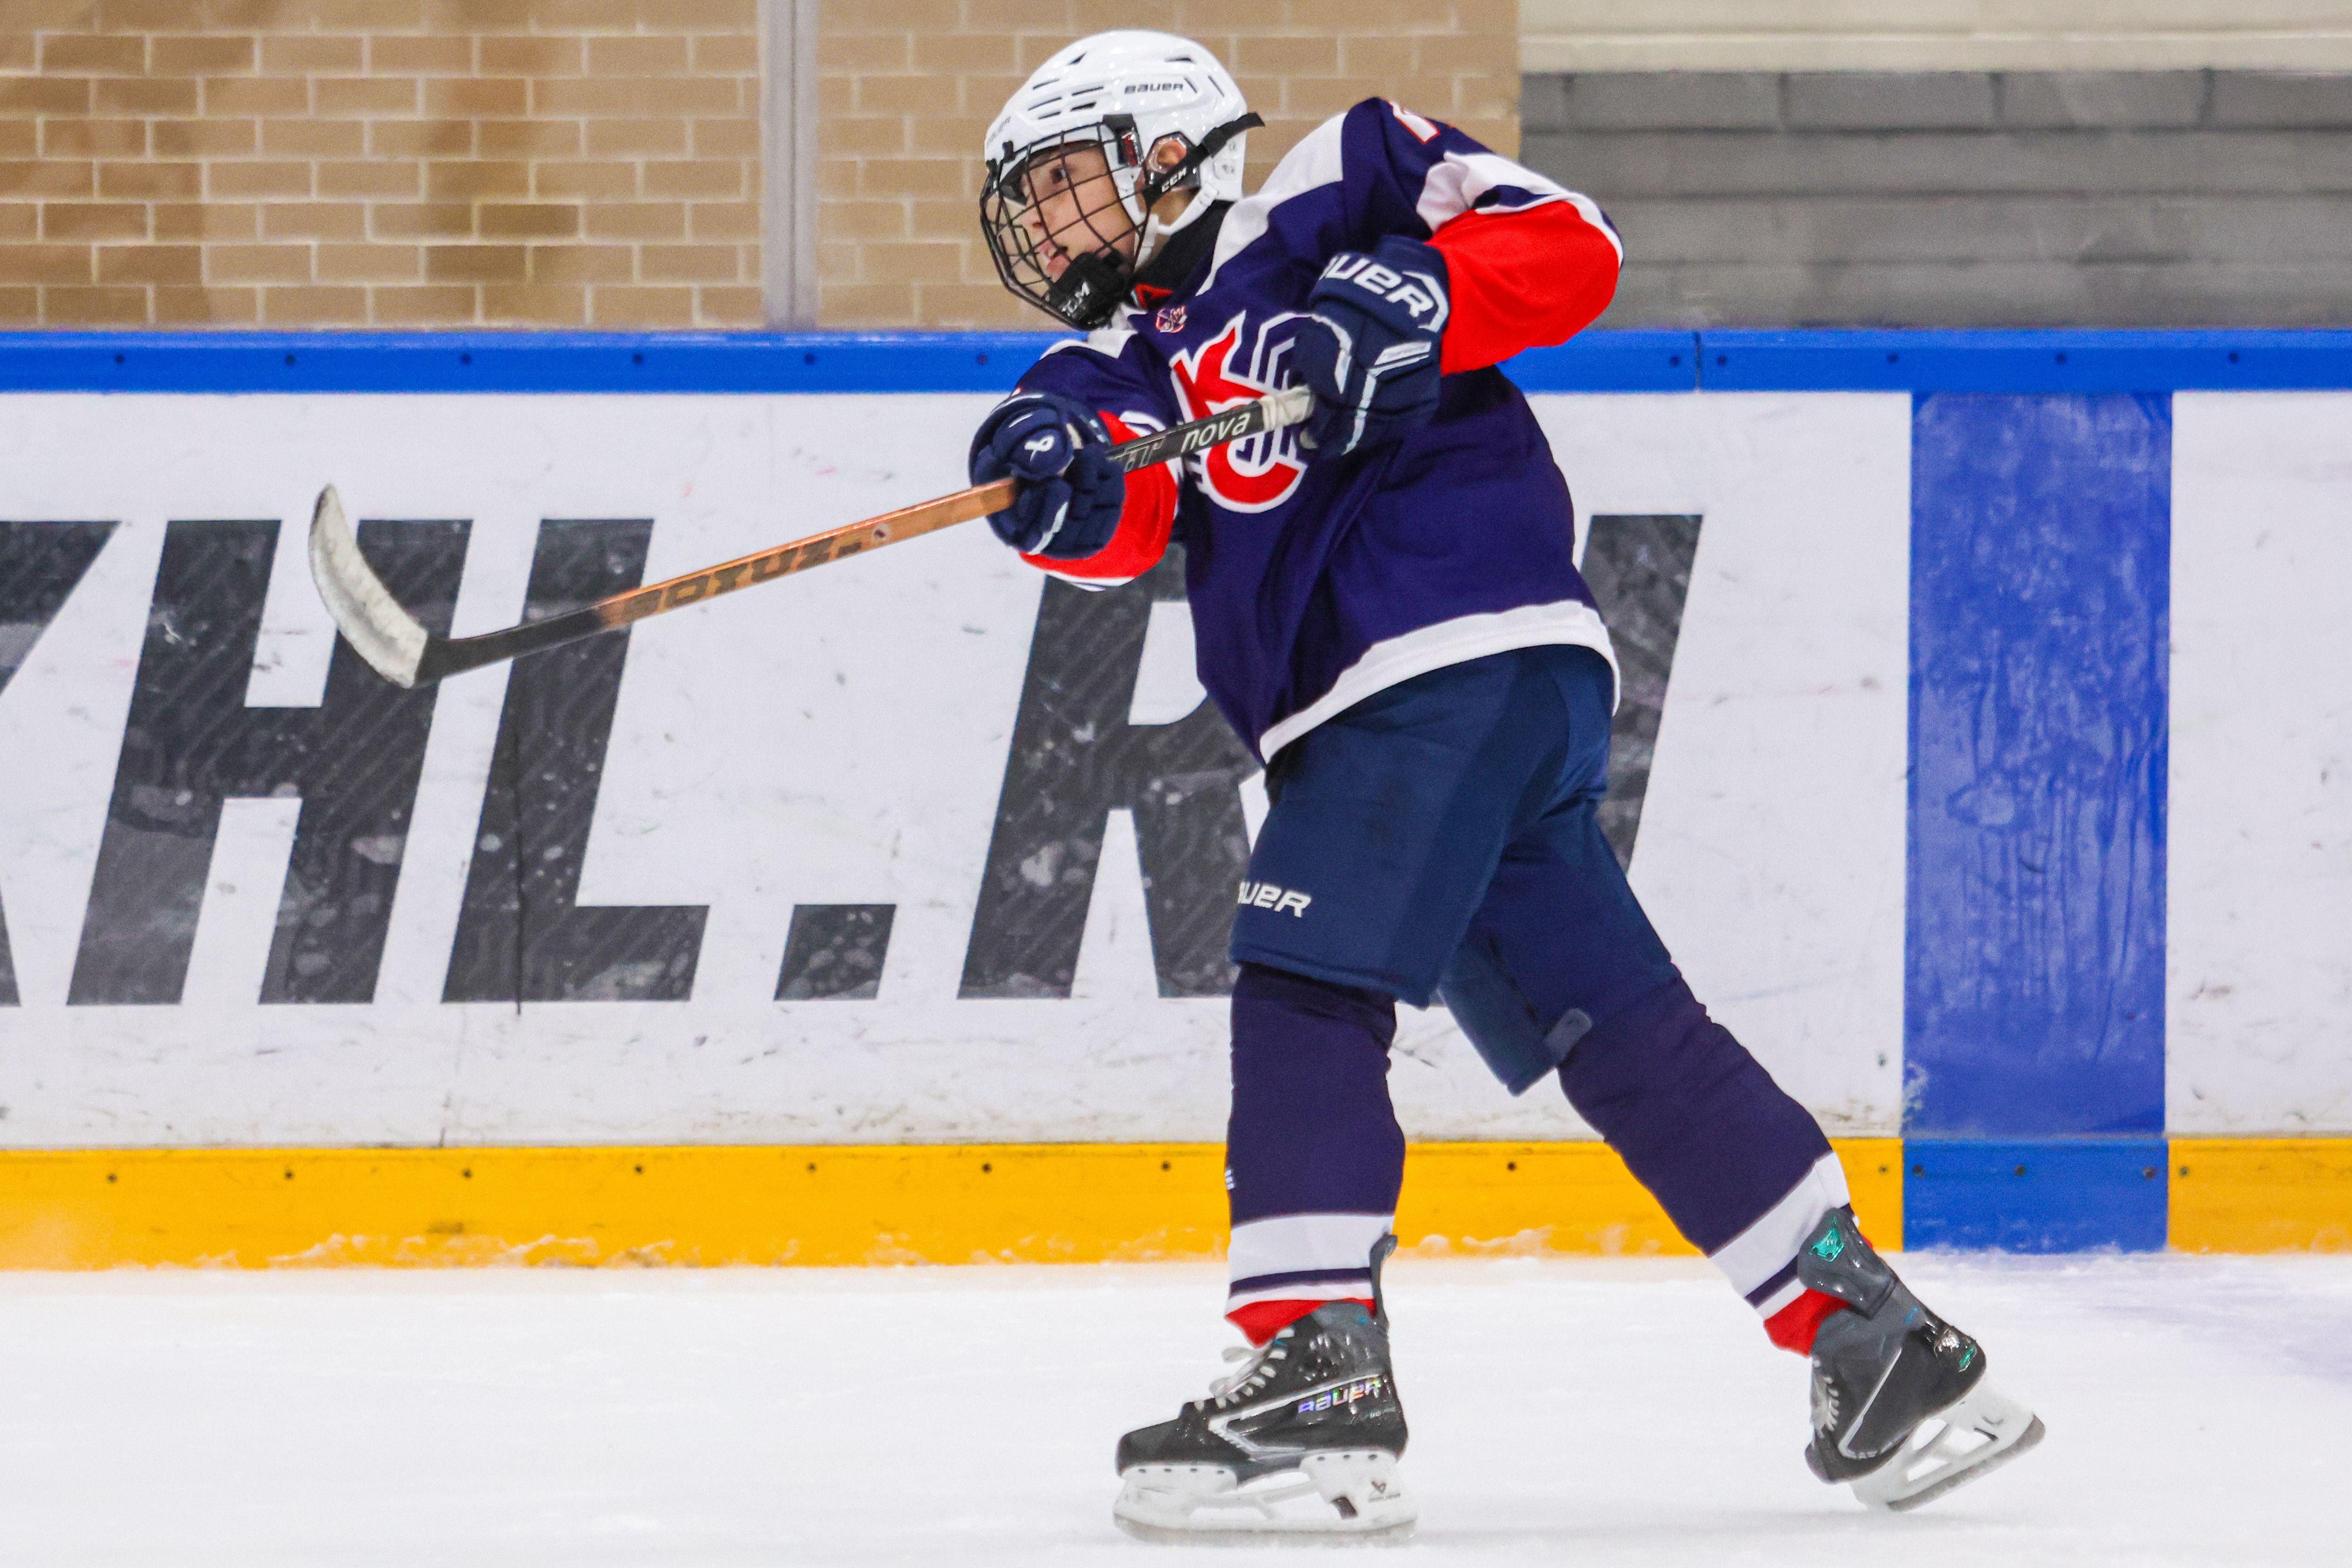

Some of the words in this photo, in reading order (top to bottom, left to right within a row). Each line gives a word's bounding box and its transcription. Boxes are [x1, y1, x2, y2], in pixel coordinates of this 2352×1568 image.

[1125, 83, 1183, 94] BAUER
[1161, 167, 1187, 193] CCM
[1319, 255, 1434, 318] UER
[1181, 412, 1250, 453] nova
[1237, 881, 1312, 918] UER
